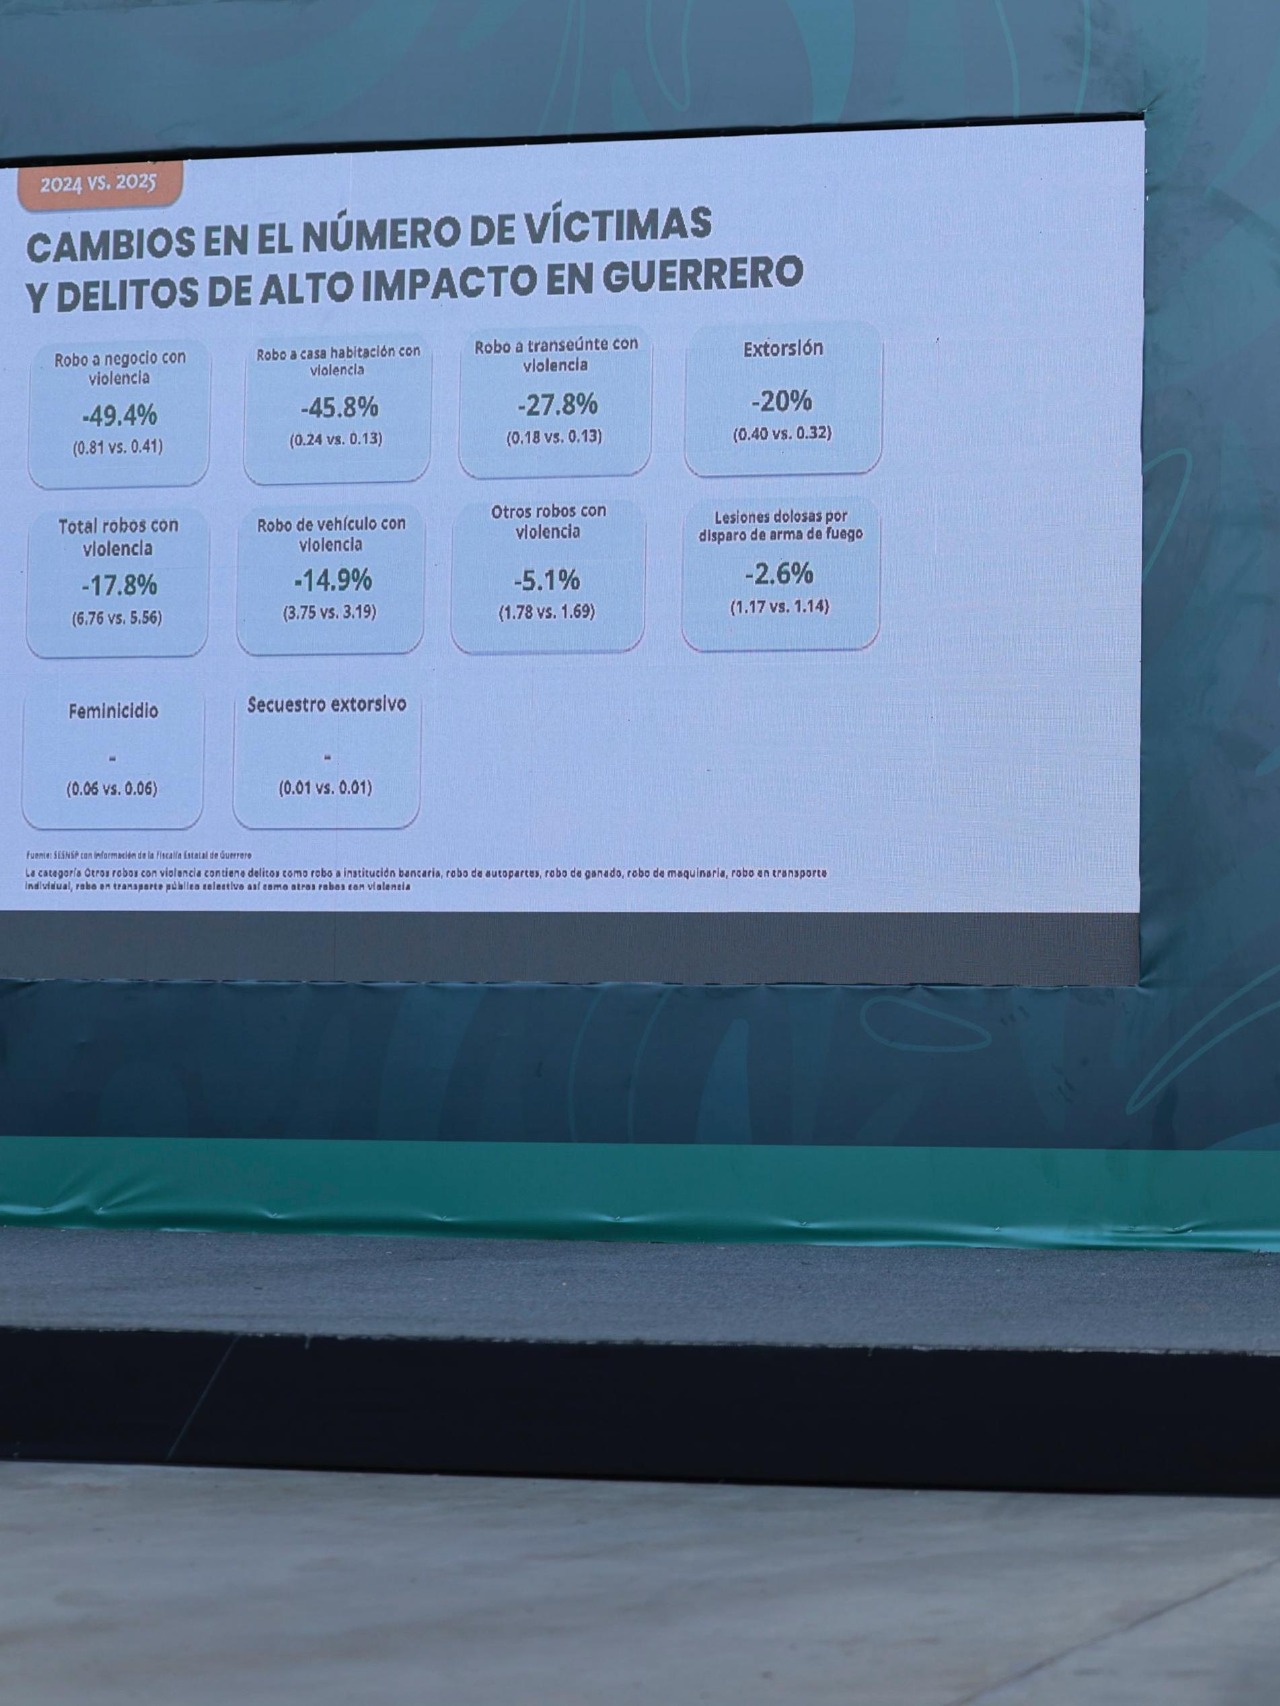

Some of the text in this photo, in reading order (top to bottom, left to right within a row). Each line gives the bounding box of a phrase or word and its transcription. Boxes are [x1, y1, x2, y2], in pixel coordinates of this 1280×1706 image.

[40, 173, 157, 195] 2024 VS. 2025
[27, 199, 712, 263] CAMBIOS EN EL NÚMERO DE VÍCTIMAS
[26, 254, 804, 314] Y DELITOS DE ALTO IMPACTO EN GUERRERO
[257, 345, 421, 362] Robo a casa habitación con
[475, 337, 639, 355] Robo a transeúnte con
[744, 339, 824, 358] Extorsión
[55, 351, 186, 368] Robo a negocio con
[523, 357, 588, 373] violencia
[89, 371, 150, 386] violencia
[310, 363, 365, 378] violencia
[301, 395, 379, 419] -45.8%
[518, 392, 598, 417] -27.8%
[752, 389, 813, 412] -20%
[82, 403, 157, 427] -49.4%
[289, 432, 383, 449] (0.24 vs. 0.13)
[506, 429, 602, 445] (0.18 vs. 0.13)
[733, 425, 832, 443] (0.40 vs. 0.32)
[72, 438, 163, 457] (0.81 vs. 0.41)
[491, 503, 607, 519] Otros robos con
[715, 509, 849, 525] Lesiones dolosas por
[59, 518, 179, 534] Total robos con
[258, 515, 406, 533] Robo de vehículo con
[515, 523, 581, 541] violencia
[699, 526, 863, 545] disparo de arma de fuego
[83, 540, 153, 558] violencia
[300, 537, 363, 553] violencia
[295, 567, 372, 593] -14.9%
[514, 568, 581, 592] -5.1%
[745, 561, 814, 585] -2.6%
[82, 573, 157, 597] -17.8%
[283, 605, 377, 622] (3.75 vs. 3.19)
[499, 603, 596, 621] (1.78 vs. 1.69)
[730, 599, 830, 616] (1.17 vs. 1.14)
[72, 610, 162, 627] (6.76 vs. 5.56)
[69, 702, 159, 720] Feminicidio
[248, 695, 407, 713] Secuestro extorsivo
[66, 780, 158, 797] (0.06 vs. 0.06)
[279, 779, 372, 797] (0.01 vs. 0.01)
